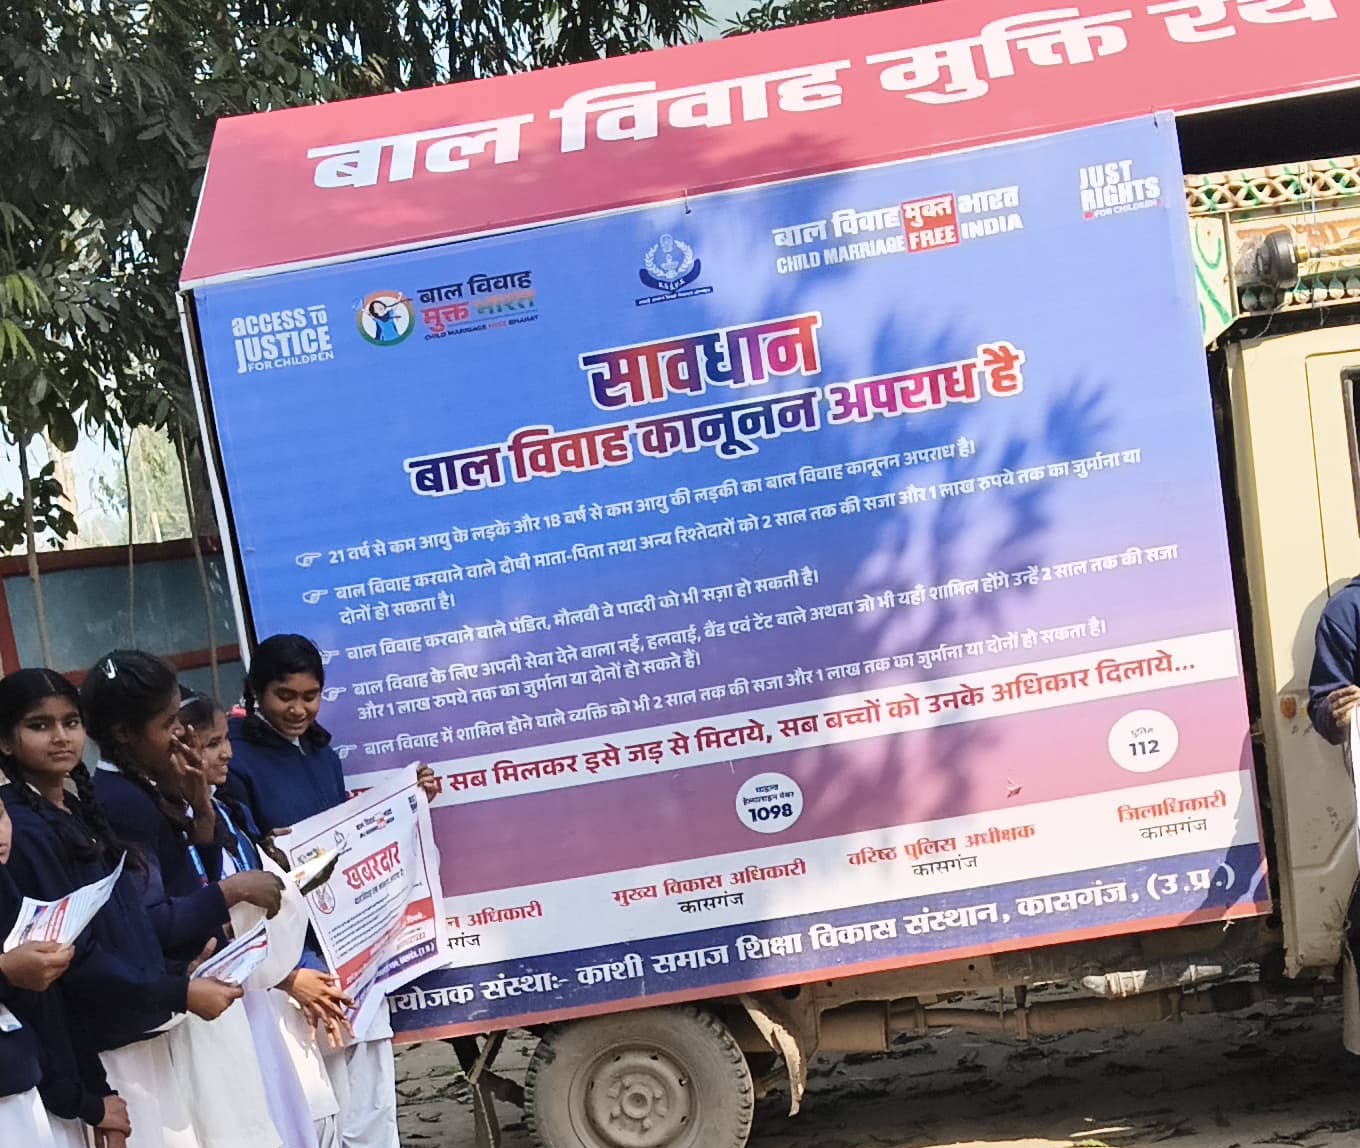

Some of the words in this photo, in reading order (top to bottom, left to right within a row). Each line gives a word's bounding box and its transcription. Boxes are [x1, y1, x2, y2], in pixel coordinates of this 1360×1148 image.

[307, 113, 535, 190] बाल
[549, 58, 852, 154] विवाह
[866, 8, 1134, 106] मुक्ति
[1077, 159, 1134, 190] JUST
[1080, 176, 1161, 212] RIGHTS
[771, 219, 828, 247] बाल
[830, 206, 901, 239] विवाह
[902, 194, 953, 229] मुक्त
[957, 185, 1020, 214] भारत
[776, 250, 822, 274] CHILD
[822, 234, 907, 266] MARRIAGE
[908, 224, 957, 251] FREE
[960, 212, 1024, 240] INDIA
[416, 282, 464, 304] बाल
[466, 270, 532, 296] विवाह
[306, 304, 328, 326] TO
[419, 301, 474, 333] मुक्त
[476, 290, 536, 317] भारत
[234, 325, 335, 374] JUSTICE
[248, 361, 273, 373] FOR
[274, 349, 333, 369] CHILDREN
[580, 312, 825, 410] सावधान
[407, 445, 507, 500] बाल
[506, 424, 634, 482] विवाह
[634, 390, 823, 458] कानूनन
[827, 362, 981, 425] अपराध
[982, 342, 1023, 397] है
[328, 549, 346, 565] 21
[345, 540, 371, 561] वर्ष
[370, 538, 388, 557] से
[387, 537, 417, 554] कम
[418, 531, 453, 552] आयु
[451, 525, 469, 544] के
[469, 519, 512, 542] लड़के
[512, 513, 542, 534] और
[542, 513, 562, 529] 18
[561, 503, 587, 525] वर्ष
[587, 502, 604, 521] से
[604, 500, 634, 517] कम
[635, 494, 670, 515] आयु
[668, 486, 692, 506] की
[692, 478, 739, 504] लड़की
[739, 477, 763, 494] का
[763, 471, 798, 490] बाल
[798, 463, 844, 485] विवाह
[843, 453, 901, 478] कानूनन
[902, 443, 956, 466] अपराध
[956, 436, 976, 458] है।
[333, 582, 367, 600] बाल
[366, 575, 412, 596] विवाह
[412, 562, 464, 588] करवाने
[464, 557, 497, 578] वाले
[497, 552, 532, 575] दोषी
[531, 543, 606, 568] माता-पिता
[605, 537, 637, 556] तथा
[639, 531, 673, 550] अन्य
[674, 516, 736, 544] रिश्तेदारों
[736, 513, 760, 533] को
[761, 514, 773, 529] 2
[772, 508, 808, 527] साल
[809, 502, 837, 521] तक
[838, 494, 861, 515] की
[862, 492, 896, 511] सजा
[938, 478, 975, 497] लाख
[976, 467, 1015, 491] रुपये
[1015, 465, 1046, 484] तक
[1046, 461, 1070, 478] का
[1071, 448, 1121, 479] जुर्माना
[1121, 448, 1142, 465] या
[338, 602, 372, 625] दोनों
[371, 600, 390, 621] हो
[390, 596, 437, 617] सकता
[436, 589, 456, 611] है।
[344, 643, 378, 660] बाल
[378, 636, 423, 656] विवाह
[423, 623, 474, 649] करवाने
[475, 617, 507, 640] वाले
[507, 614, 552, 634] पंडित,
[552, 603, 601, 627] मौलवी
[615, 593, 657, 616] पादरी
[657, 589, 681, 609] को
[680, 585, 700, 605] भी
[734, 577, 753, 598] हो
[753, 569, 800, 593] सकती
[800, 565, 820, 587] है।
[357, 699, 385, 720] और
[385, 702, 395, 716] 1
[395, 696, 431, 715] लाख
[469, 685, 498, 703] तक
[497, 681, 521, 697] का
[520, 671, 568, 699] जुर्माना
[568, 670, 588, 686] या
[588, 660, 622, 684] दोनों
[622, 658, 641, 679] हो
[640, 650, 682, 674] सकते
[446, 768, 488, 792] सब
[490, 754, 579, 785] मिलकर
[581, 742, 621, 775] इसे
[624, 739, 664, 765] जड़
[666, 730, 691, 756] से
[693, 718, 773, 752] मिटाये,
[776, 713, 819, 738] सब
[822, 698, 881, 729] बच्चों
[885, 692, 920, 719] को
[924, 683, 985, 714] उनके
[991, 668, 1091, 702] अधिकार
[1128, 739, 1160, 757] 112
[747, 802, 794, 823] 1098
[1116, 789, 1227, 824] जिलाधिकारी
[1139, 815, 1207, 840] कासगंज
[342, 841, 401, 890] खबरदार
[846, 846, 898, 866] वरिष्ठ
[903, 832, 960, 861] पुलिस
[963, 821, 1036, 848] अधीक्षक
[911, 851, 977, 877] कासगंज
[611, 884, 658, 907] मुख्य
[662, 870, 722, 897] विकास
[729, 857, 807, 886] अधिकारी
[676, 890, 744, 914] कासगंज
[467, 899, 543, 927] अधिकारी
[574, 952, 645, 986] काशी
[649, 944, 730, 974] समाज
[734, 933, 803, 962] शिक्षा
[807, 917, 898, 950] विकास
